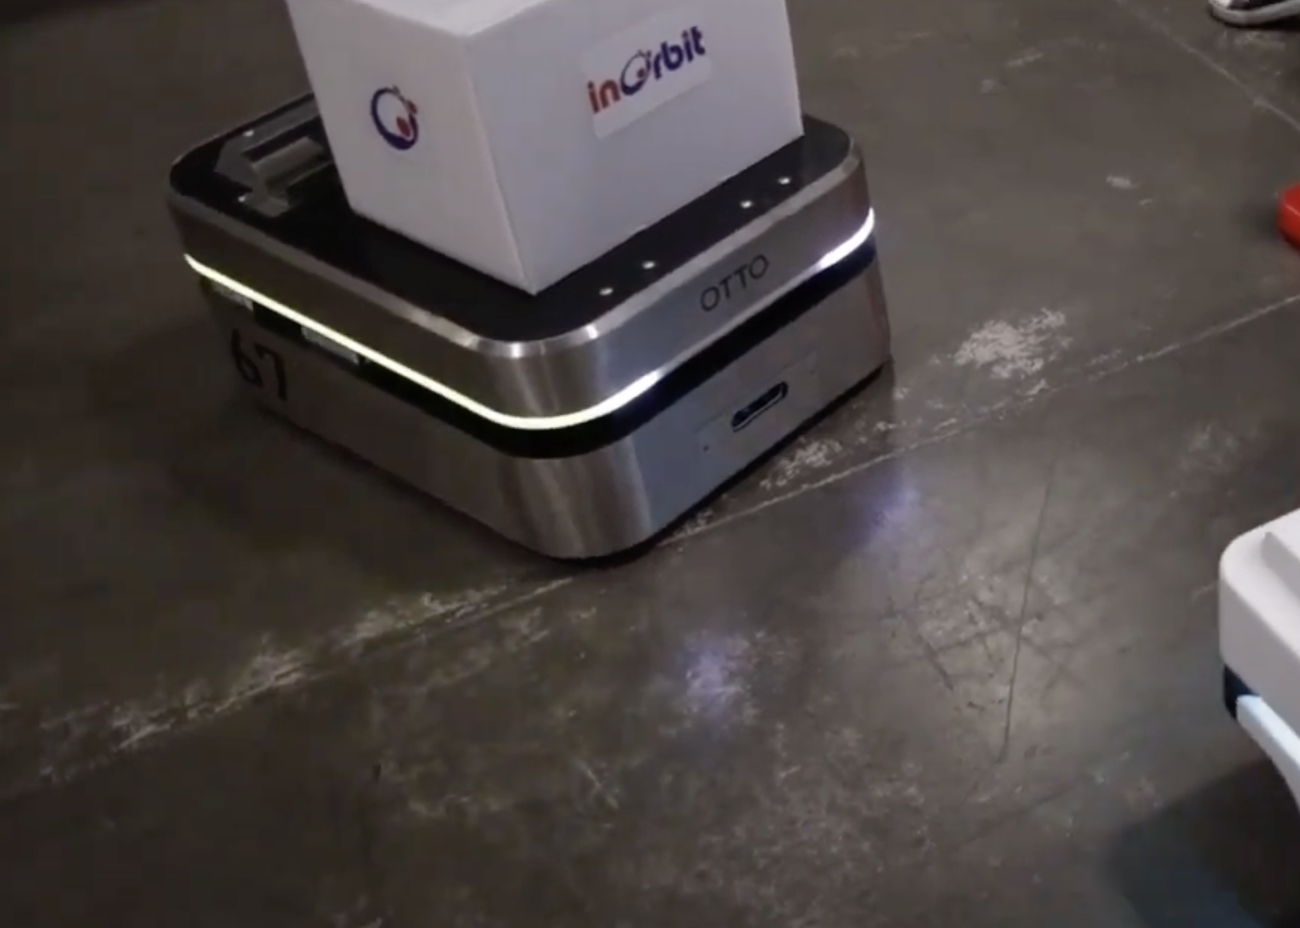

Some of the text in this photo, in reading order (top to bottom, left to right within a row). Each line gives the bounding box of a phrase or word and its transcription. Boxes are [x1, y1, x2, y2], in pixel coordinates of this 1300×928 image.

[587, 26, 706, 114] inOrbit
[700, 253, 770, 313] OTTO
[230, 328, 288, 402] 67
